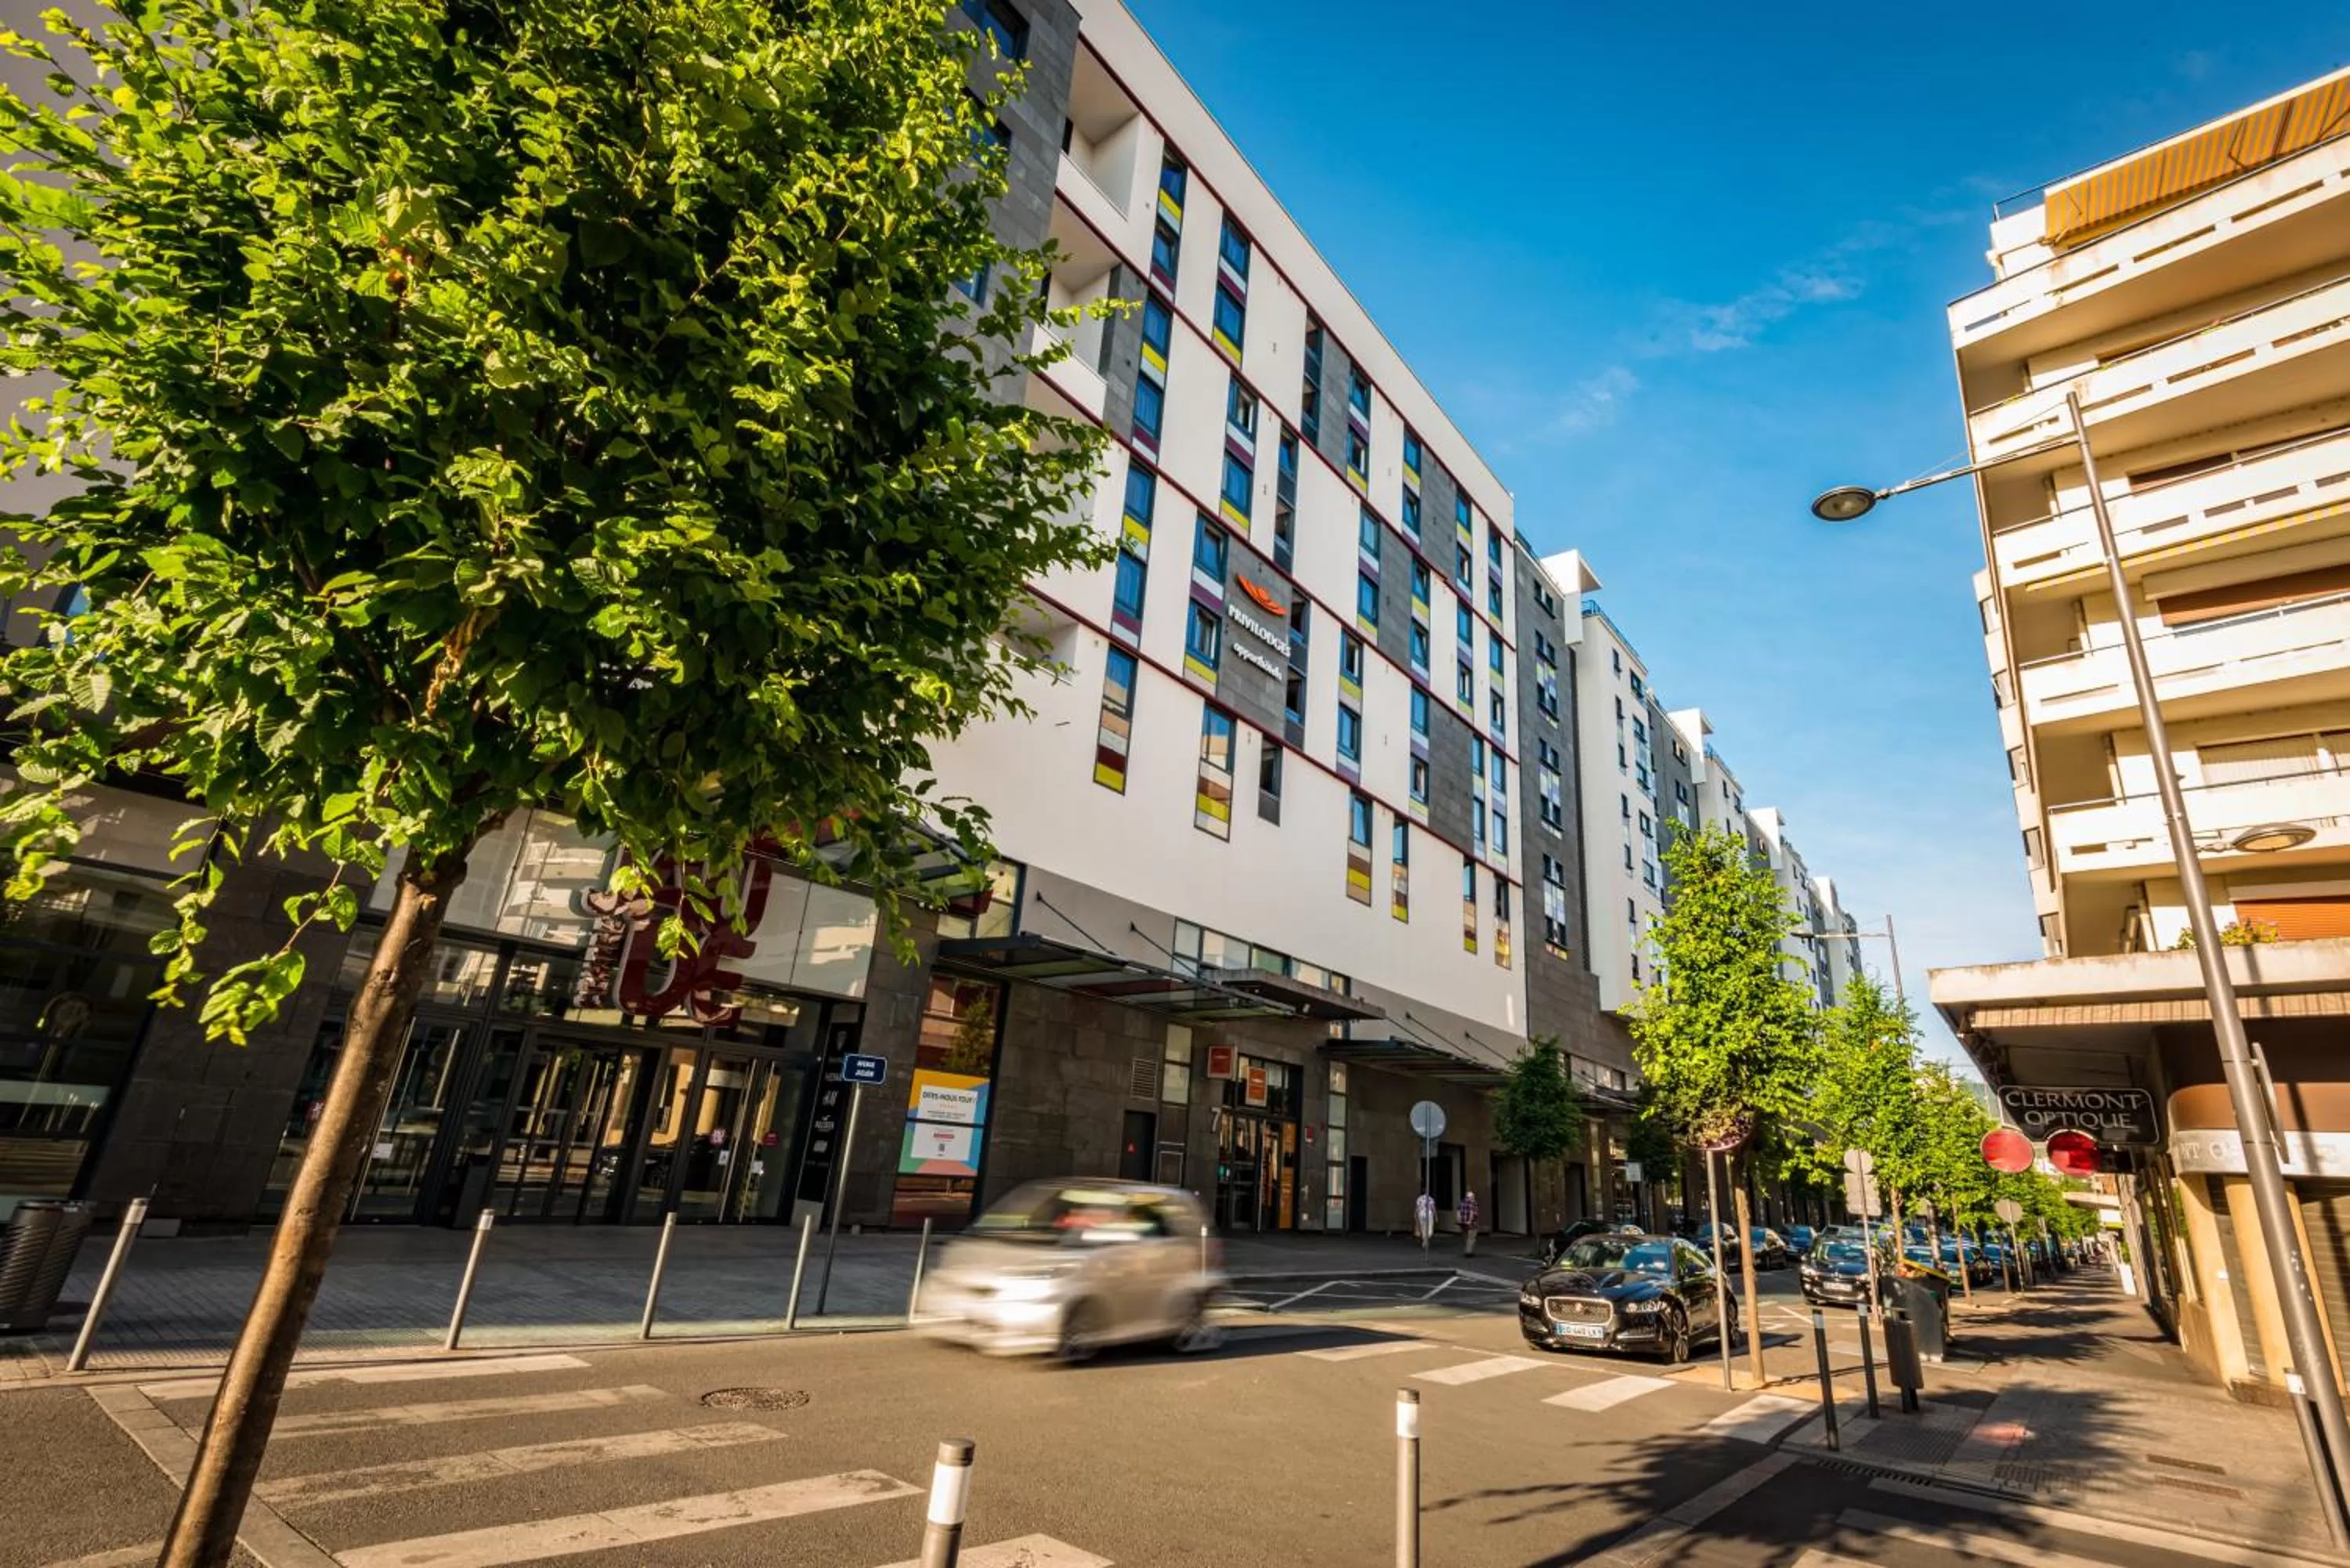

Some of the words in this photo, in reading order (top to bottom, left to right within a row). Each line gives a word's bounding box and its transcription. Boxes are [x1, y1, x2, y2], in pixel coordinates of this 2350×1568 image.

[2005, 1090, 2142, 1110] CLERMONT
[1211, 1106, 1221, 1133] 7
[2024, 1110, 2138, 1130] OPTIQUE
